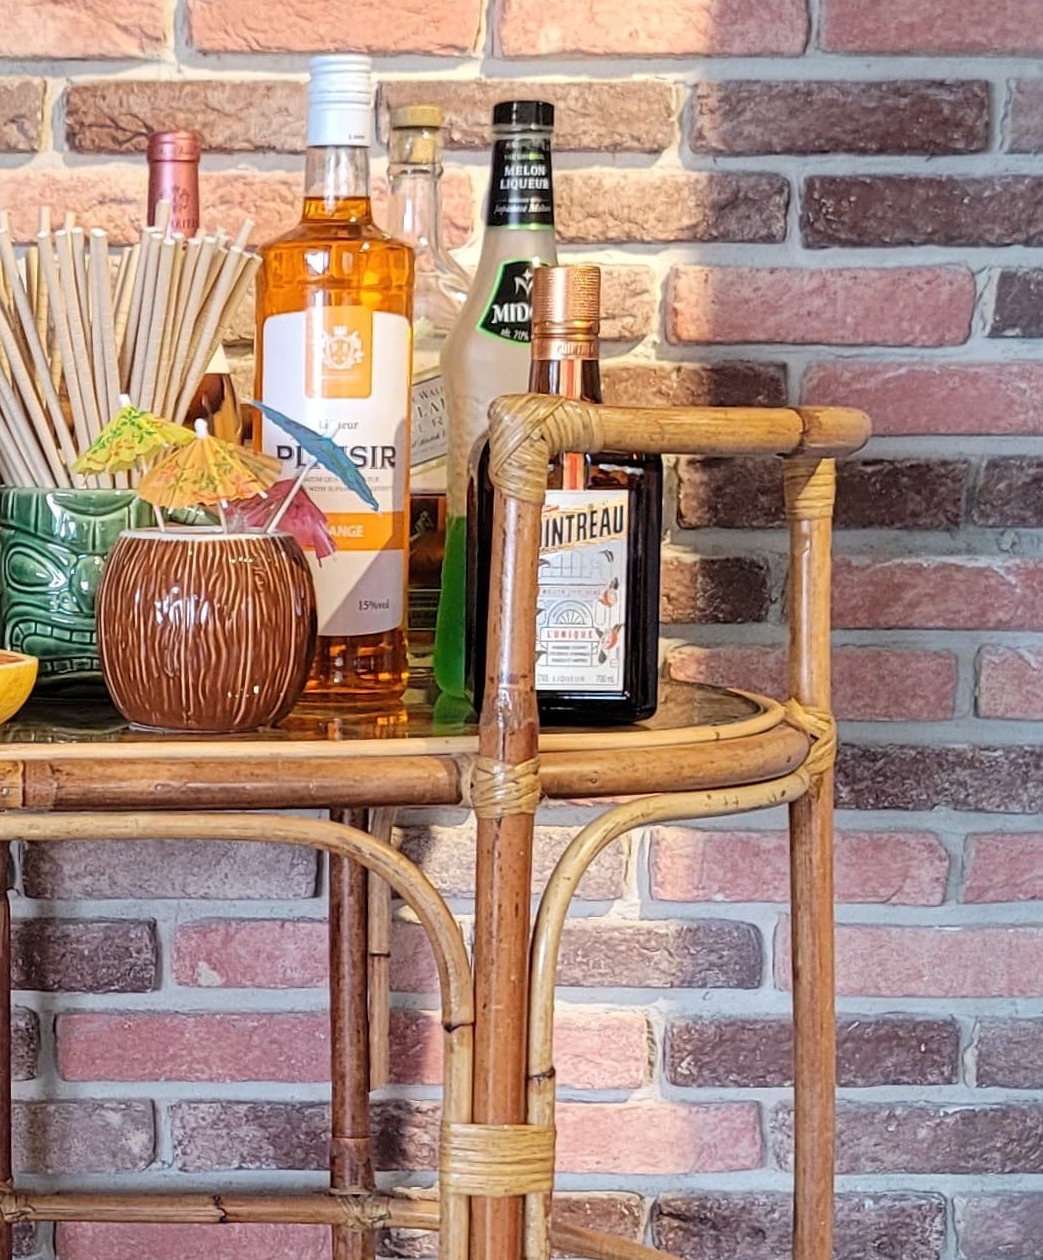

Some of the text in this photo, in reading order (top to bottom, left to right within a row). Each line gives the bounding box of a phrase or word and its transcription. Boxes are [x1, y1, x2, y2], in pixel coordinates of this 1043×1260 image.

[504, 164, 546, 177] MELON
[500, 178, 550, 191] LIQUEUR
[491, 302, 532, 324] MID
[277, 445, 397, 471] PLSIR
[329, 525, 365, 538] ANGE
[542, 505, 624, 548] INTREAU
